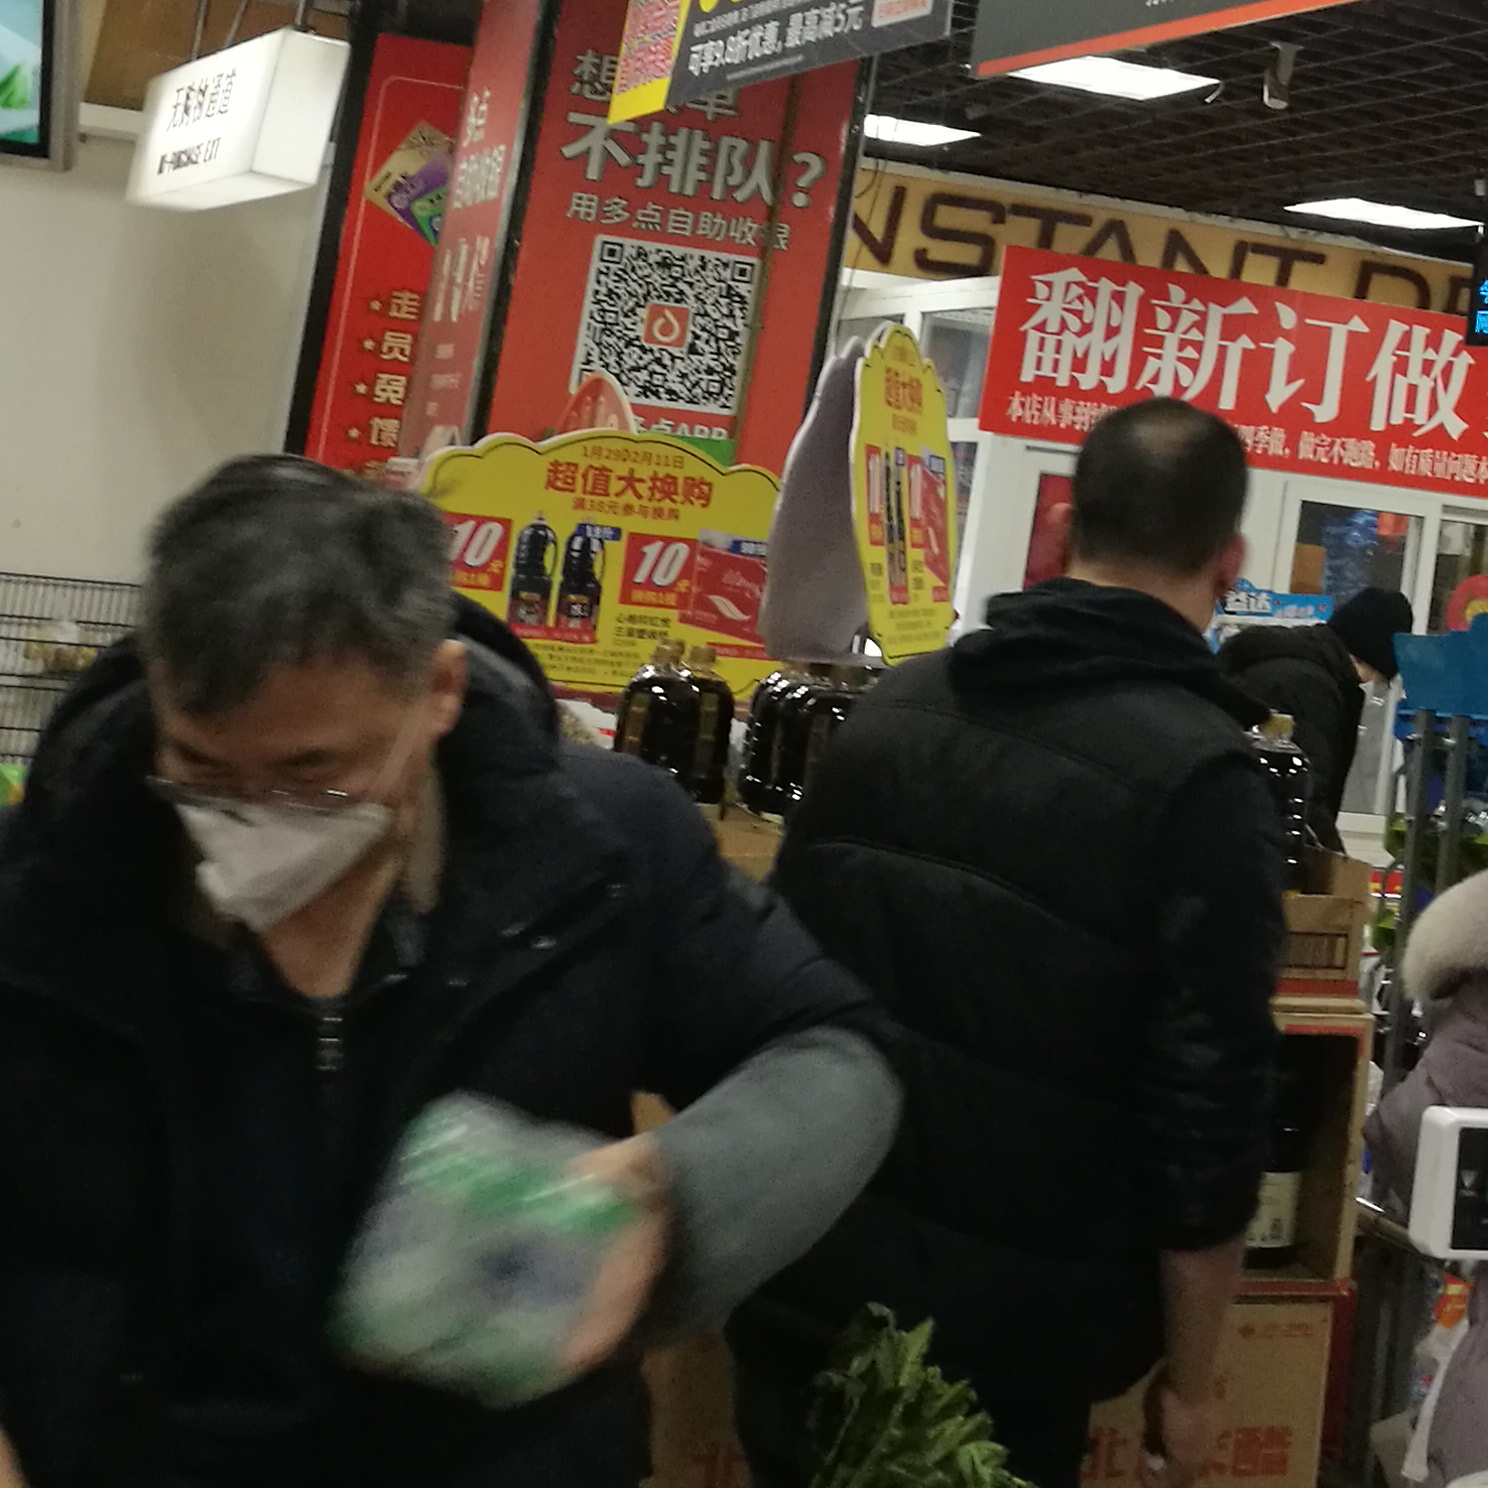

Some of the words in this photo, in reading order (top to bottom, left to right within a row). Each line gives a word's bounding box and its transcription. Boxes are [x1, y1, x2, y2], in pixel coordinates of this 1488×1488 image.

[1019, 267, 1475, 441] 翻新订做
[544, 460, 713, 508] 超值大换购
[632, 540, 691, 587] 10
